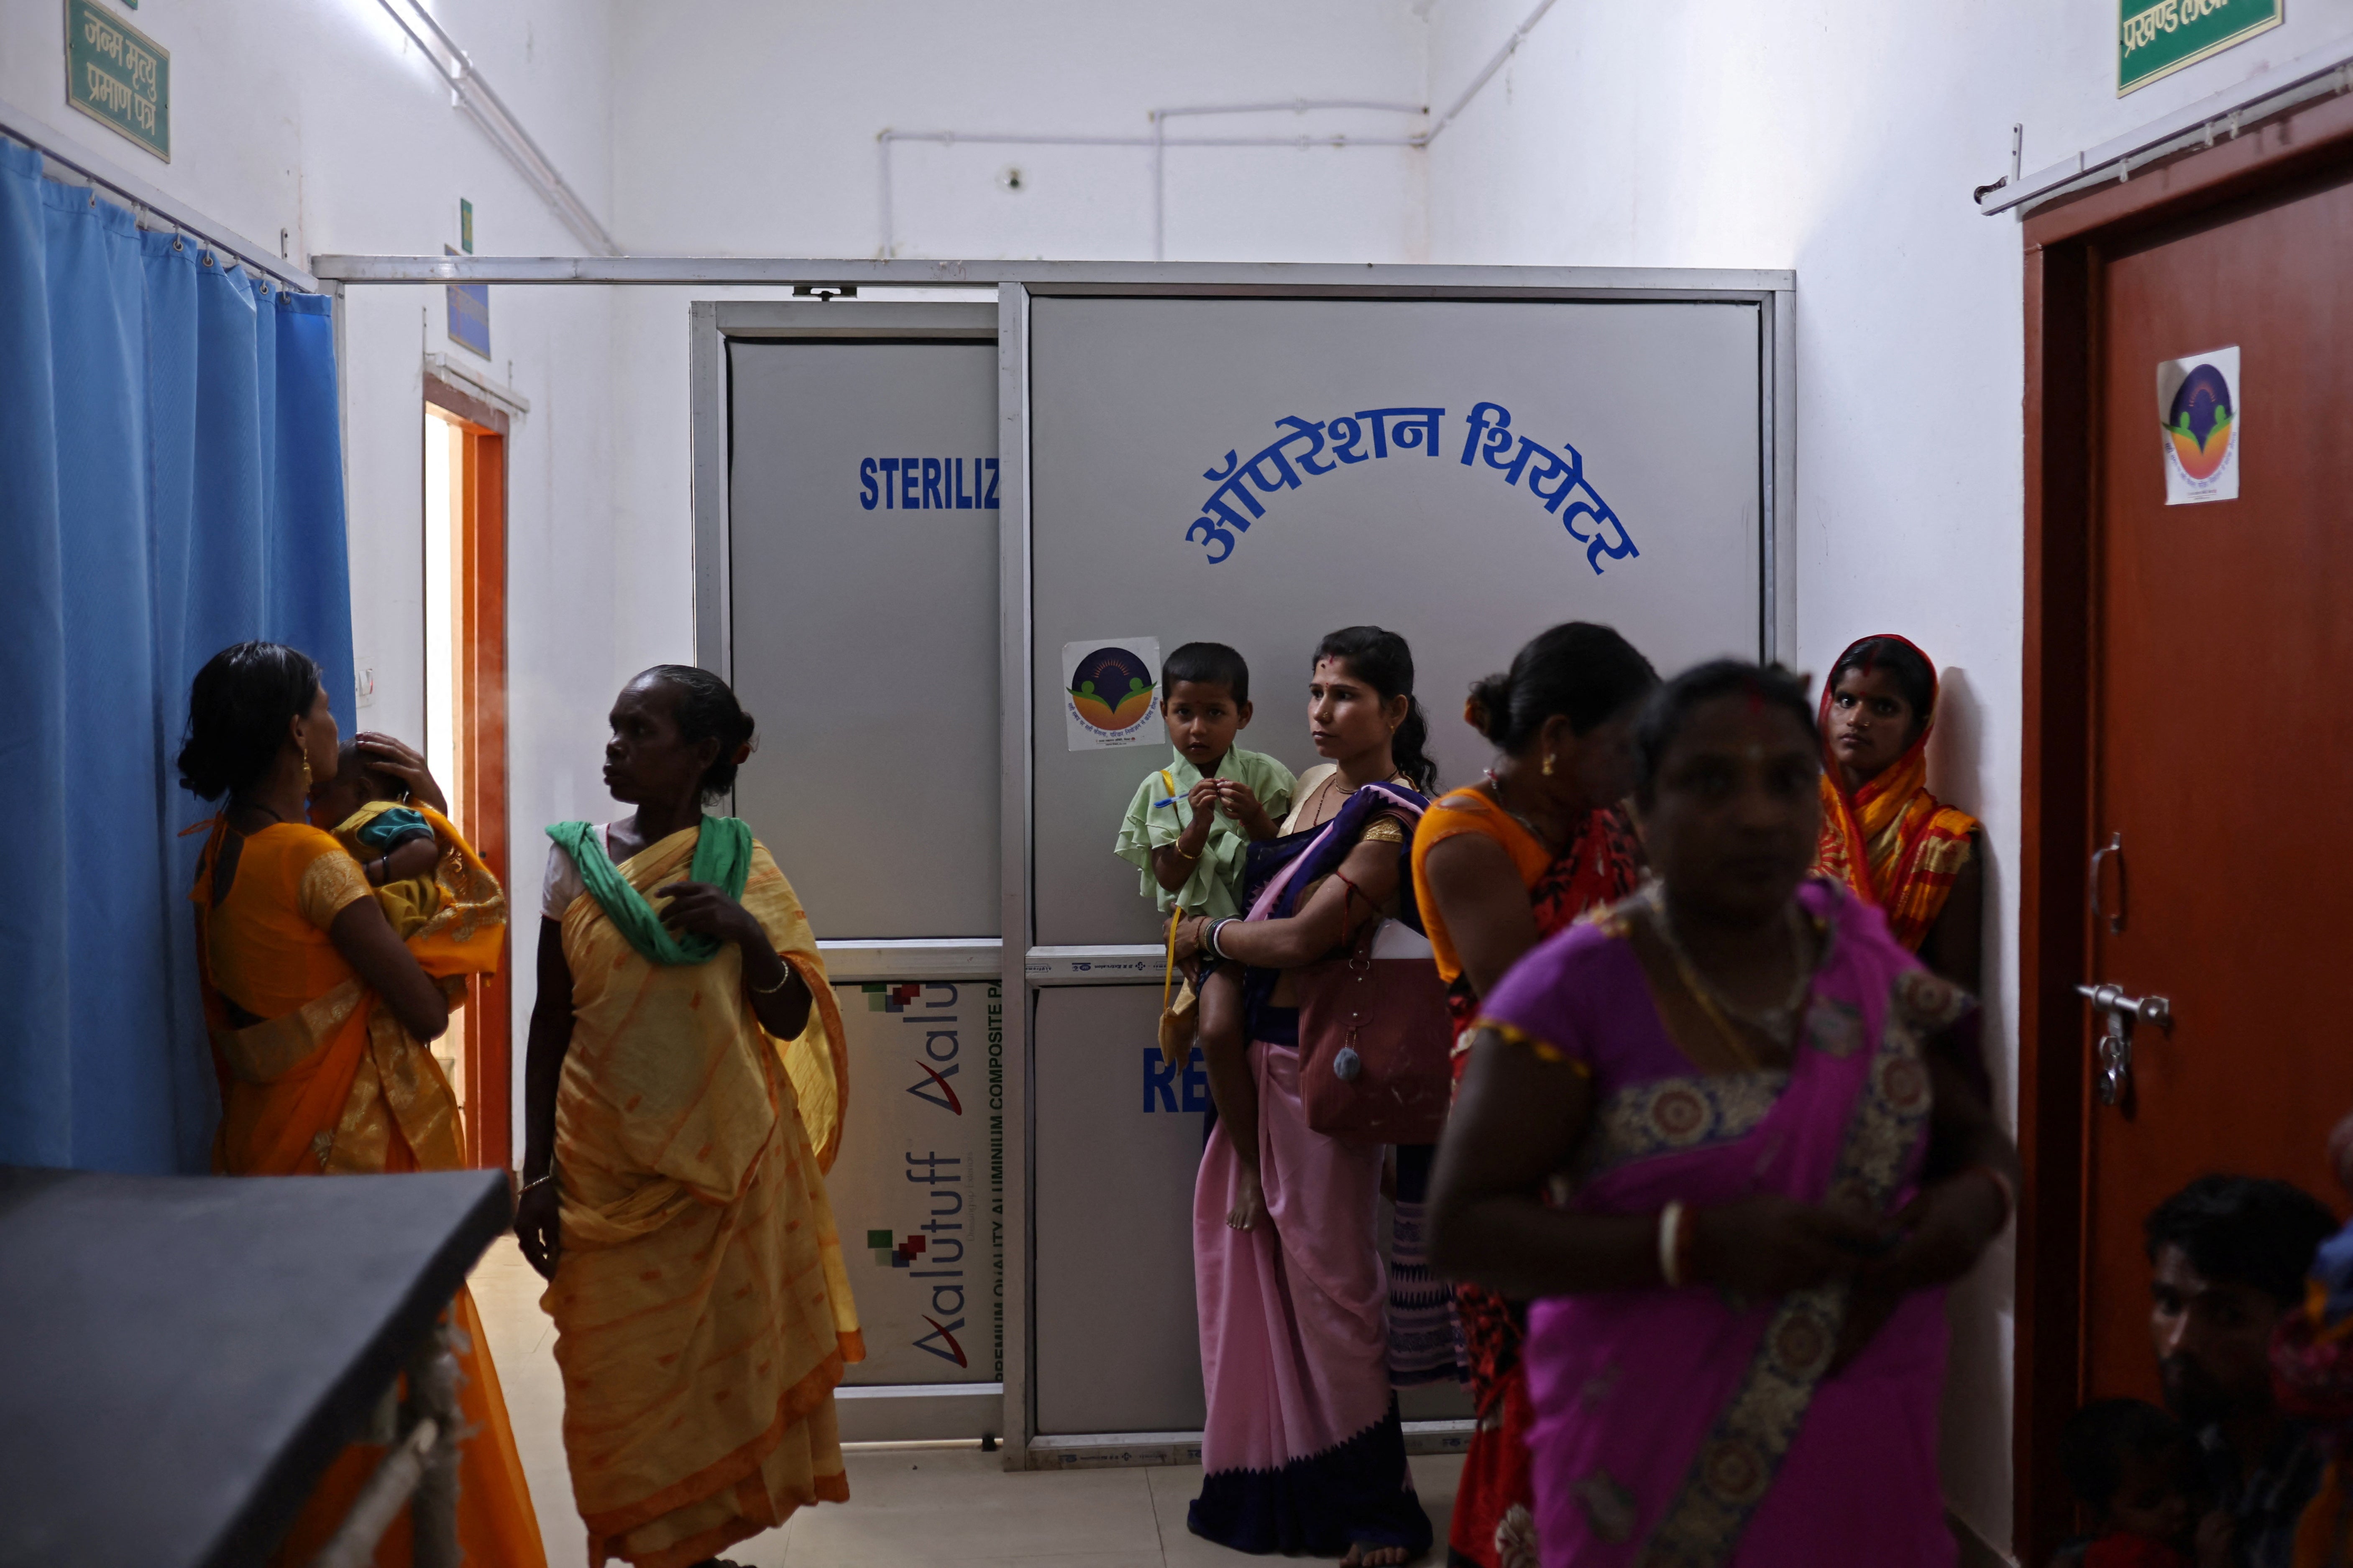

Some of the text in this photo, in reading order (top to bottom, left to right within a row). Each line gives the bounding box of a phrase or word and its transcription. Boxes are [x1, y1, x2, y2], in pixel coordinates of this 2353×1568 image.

[84, 10, 157, 102] जन्म मृत्यु
[87, 62, 156, 135] प्रमाण पत्र
[860, 457, 999, 510] STERILIZ
[1185, 401, 1640, 575] ऑपरेशन थियेटर
[988, 1004, 1003, 1110] COMPOSITE
[1143, 1047, 1207, 1113] RE
[905, 1151, 967, 1369] Aalutuff
